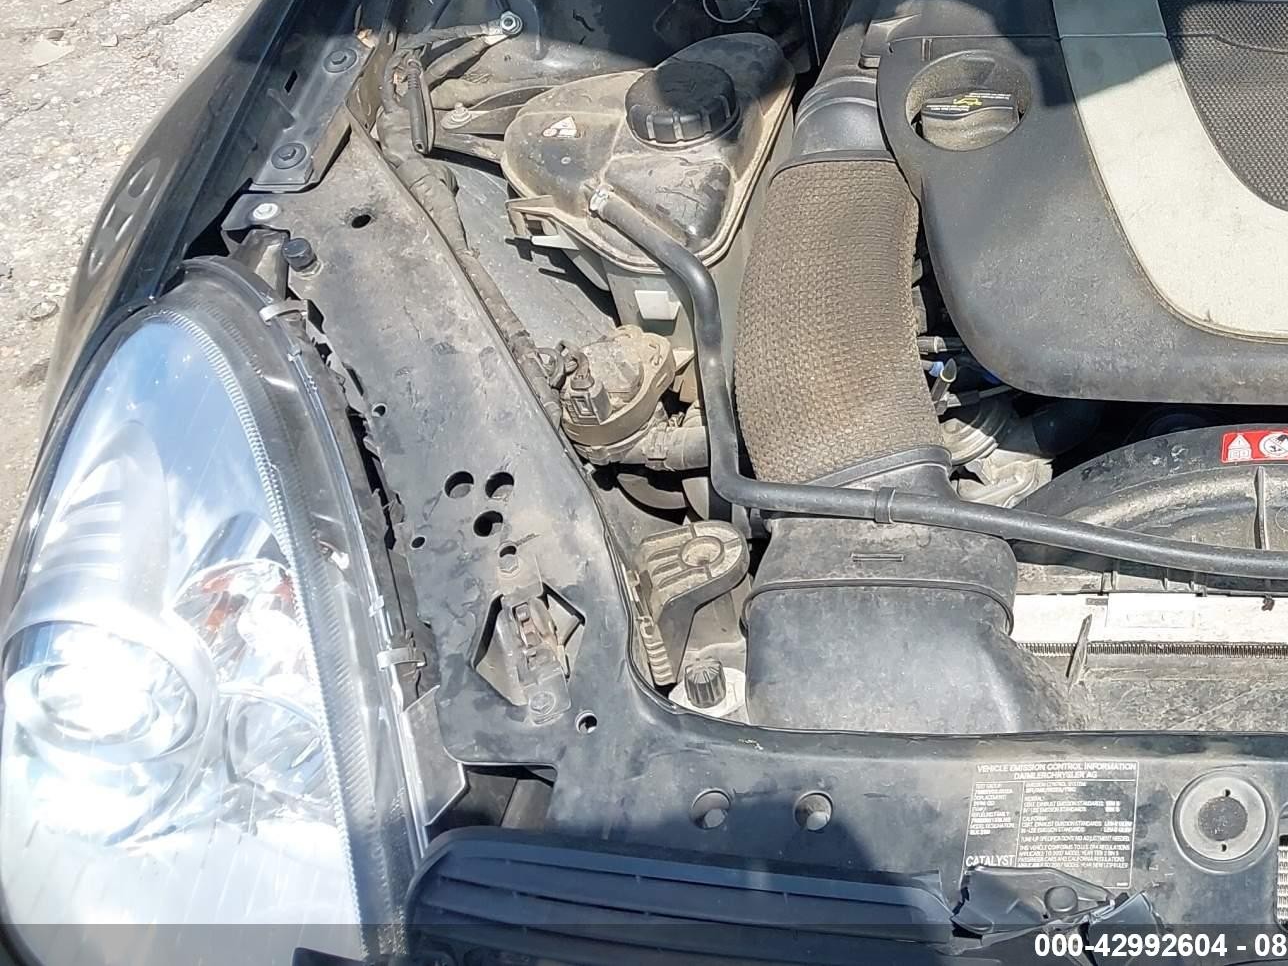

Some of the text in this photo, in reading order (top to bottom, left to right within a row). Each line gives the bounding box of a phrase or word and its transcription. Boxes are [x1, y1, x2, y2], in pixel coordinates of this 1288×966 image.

[977, 763, 1136, 773] VEHICLE EMISSION CONTROL INFORMATION
[1085, 771, 1097, 779] AG
[966, 855, 1016, 867] CATALYST
